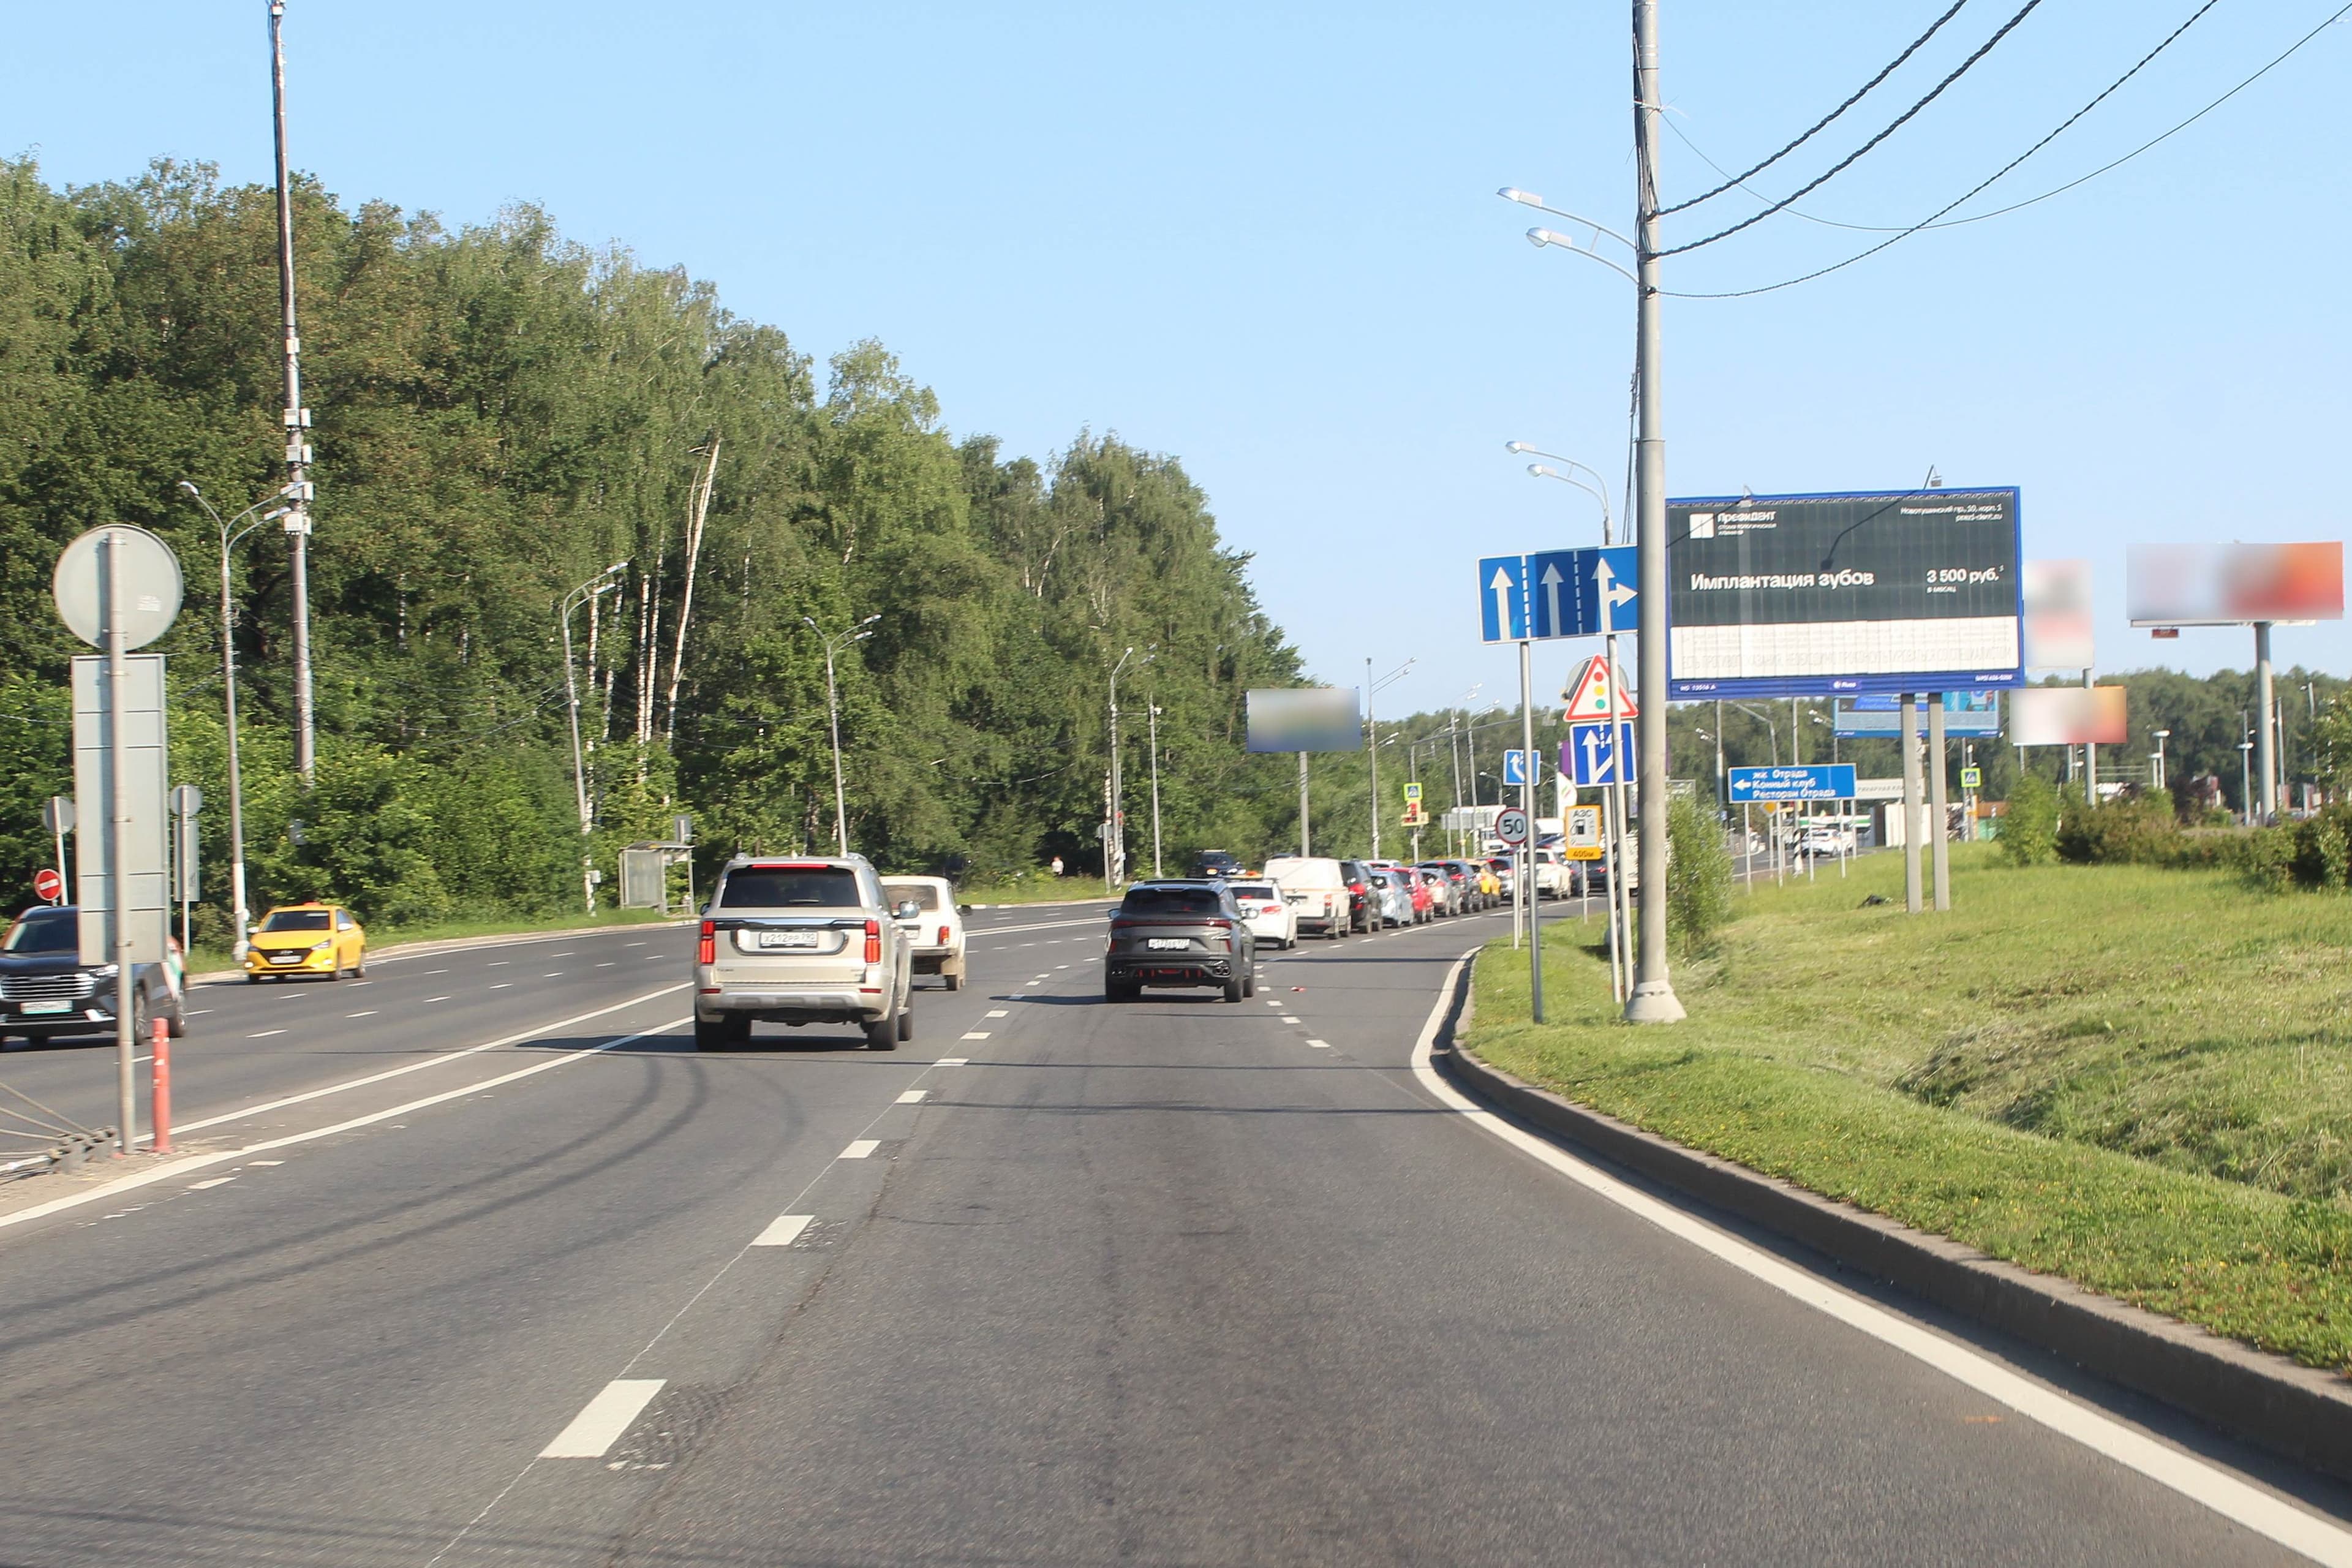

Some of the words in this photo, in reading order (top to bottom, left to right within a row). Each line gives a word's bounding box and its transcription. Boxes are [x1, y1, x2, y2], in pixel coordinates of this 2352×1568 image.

[1691, 573, 1815, 590] Имплантация
[1818, 569, 1874, 589] зубов
[1926, 569, 1937, 583] 3
[1939, 568, 1967, 582] 500
[1772, 769, 1807, 780] Отрада
[1752, 778, 1790, 789] Конный
[1792, 777, 1816, 789] клуб
[1752, 790, 1798, 800] Ресторан
[1800, 788, 1836, 799] Отрада
[1572, 809, 1593, 818] АЗС
[1503, 818, 1525, 835] 50
